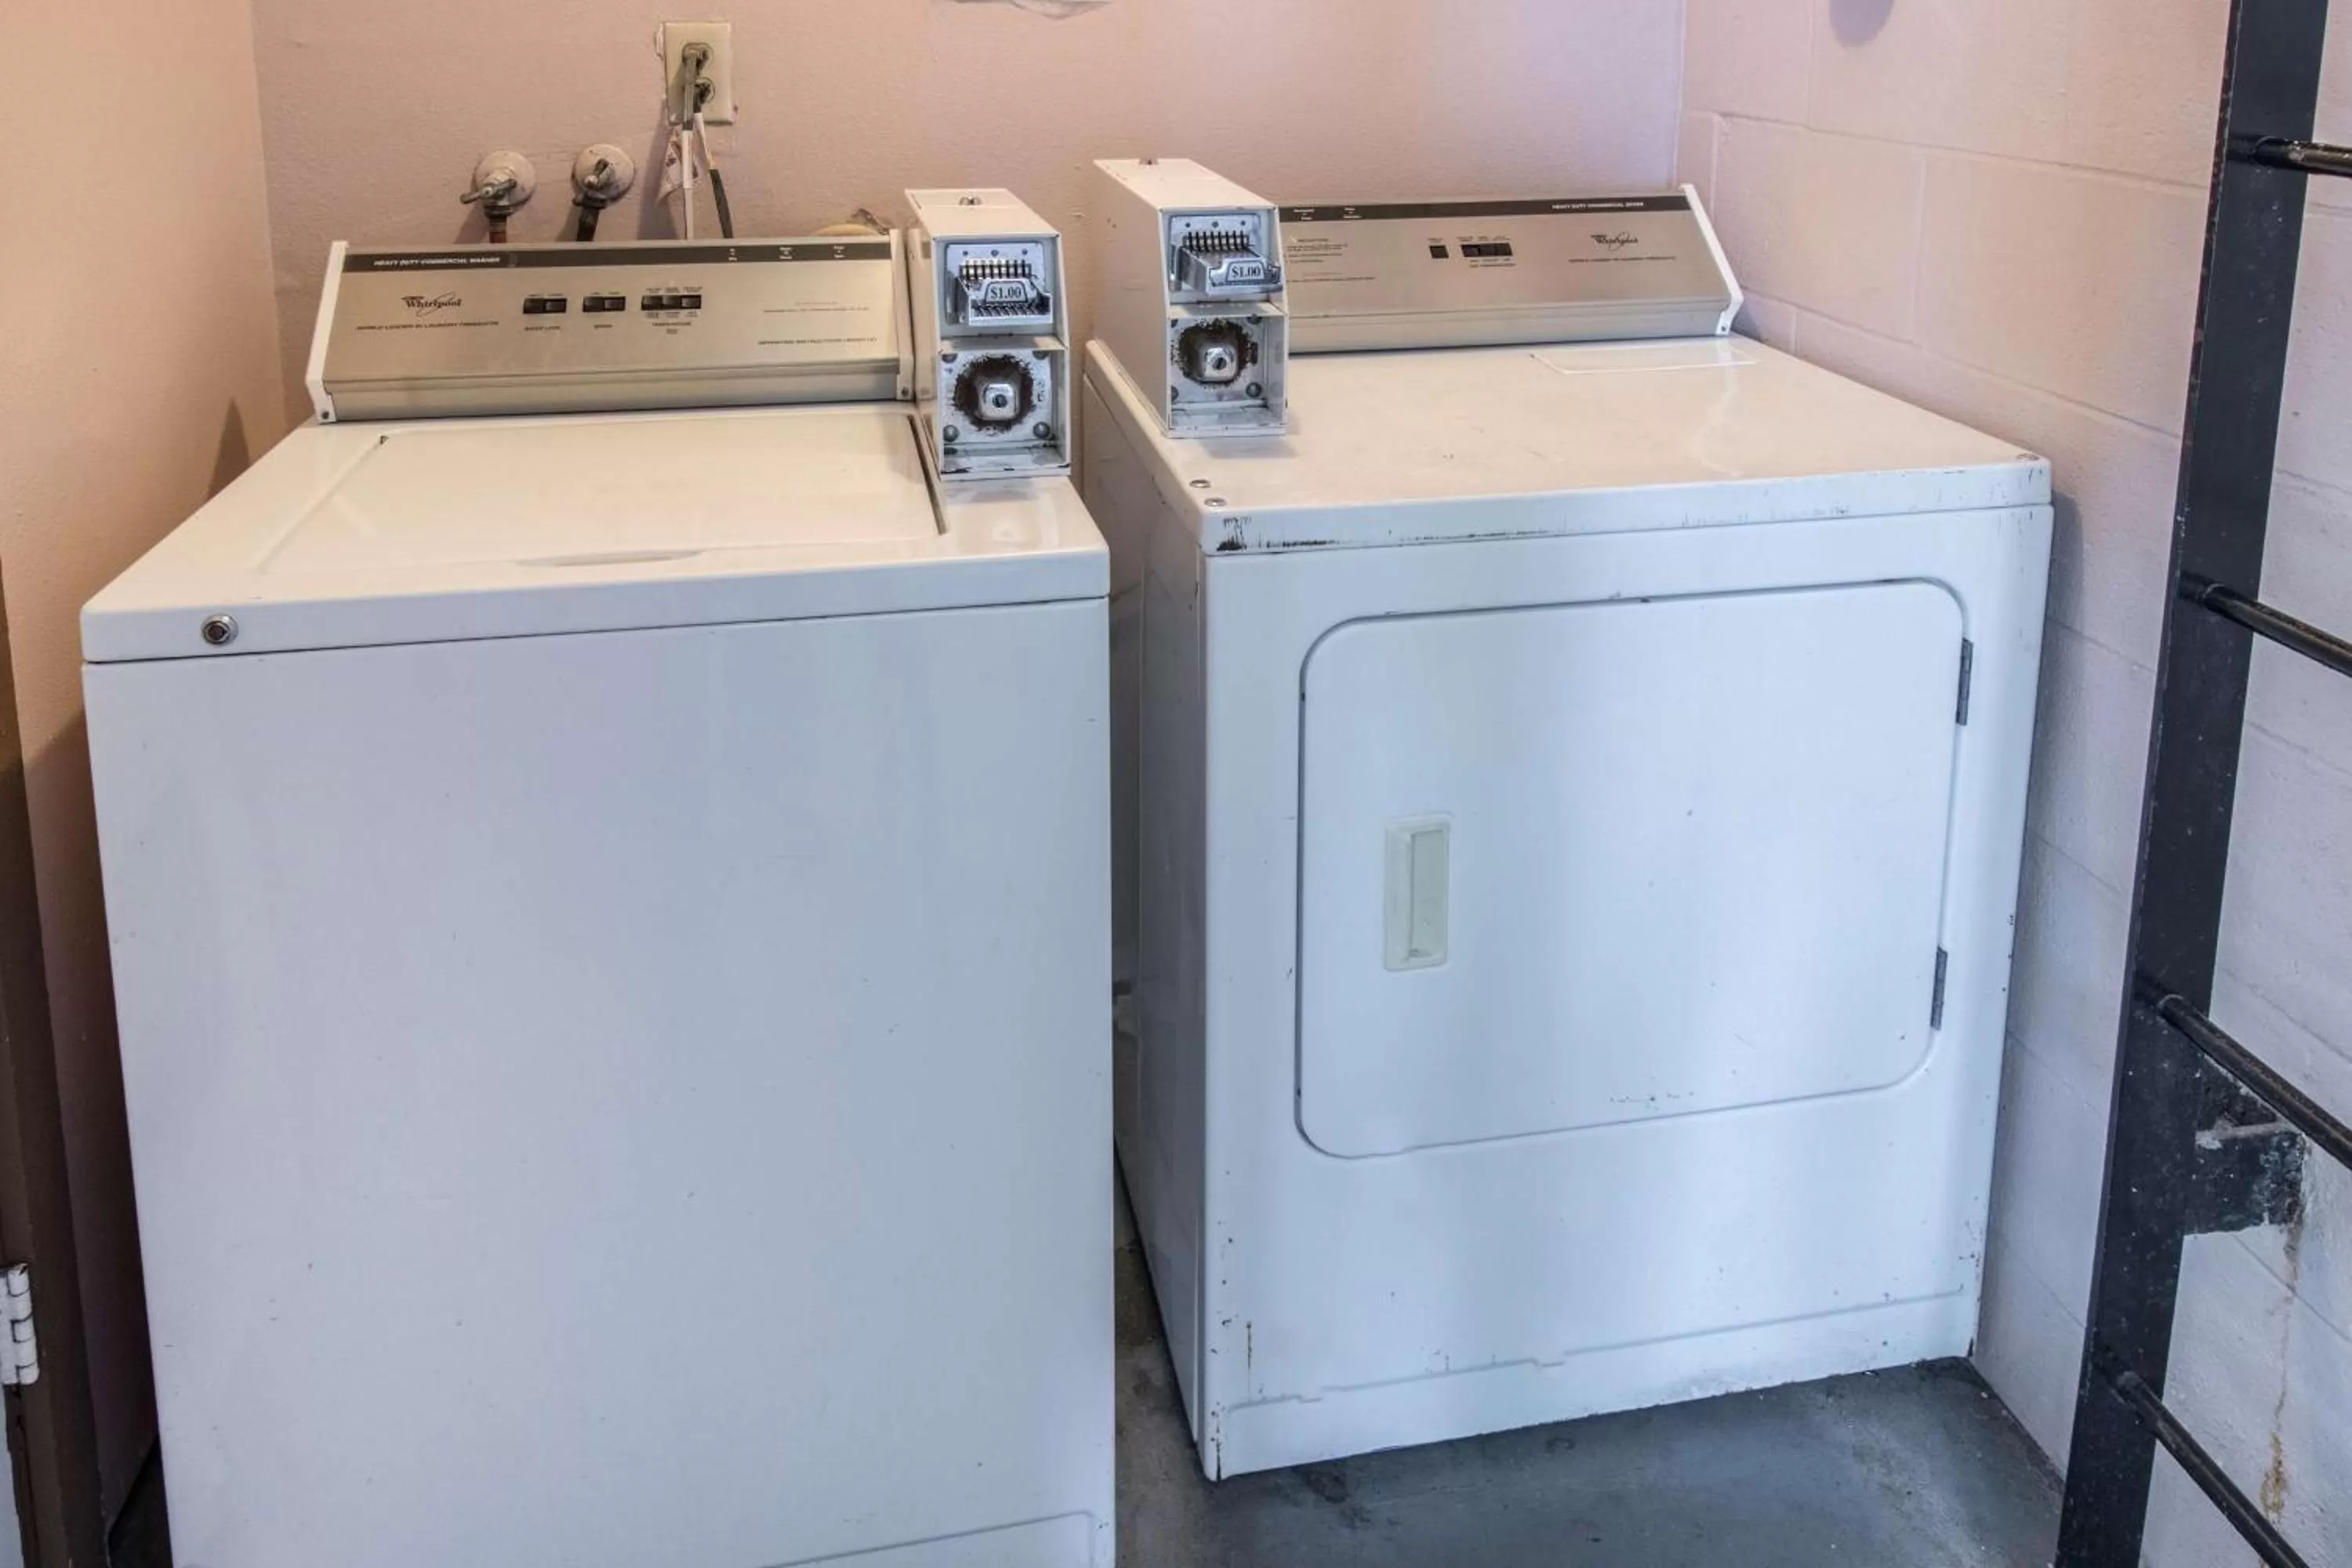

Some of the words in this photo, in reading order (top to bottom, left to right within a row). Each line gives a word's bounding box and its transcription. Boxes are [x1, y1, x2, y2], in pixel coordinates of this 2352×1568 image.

[1232, 265, 1261, 278] $1.00
[990, 286, 1022, 299] $1.00
[401, 293, 463, 312] Whirlpool
